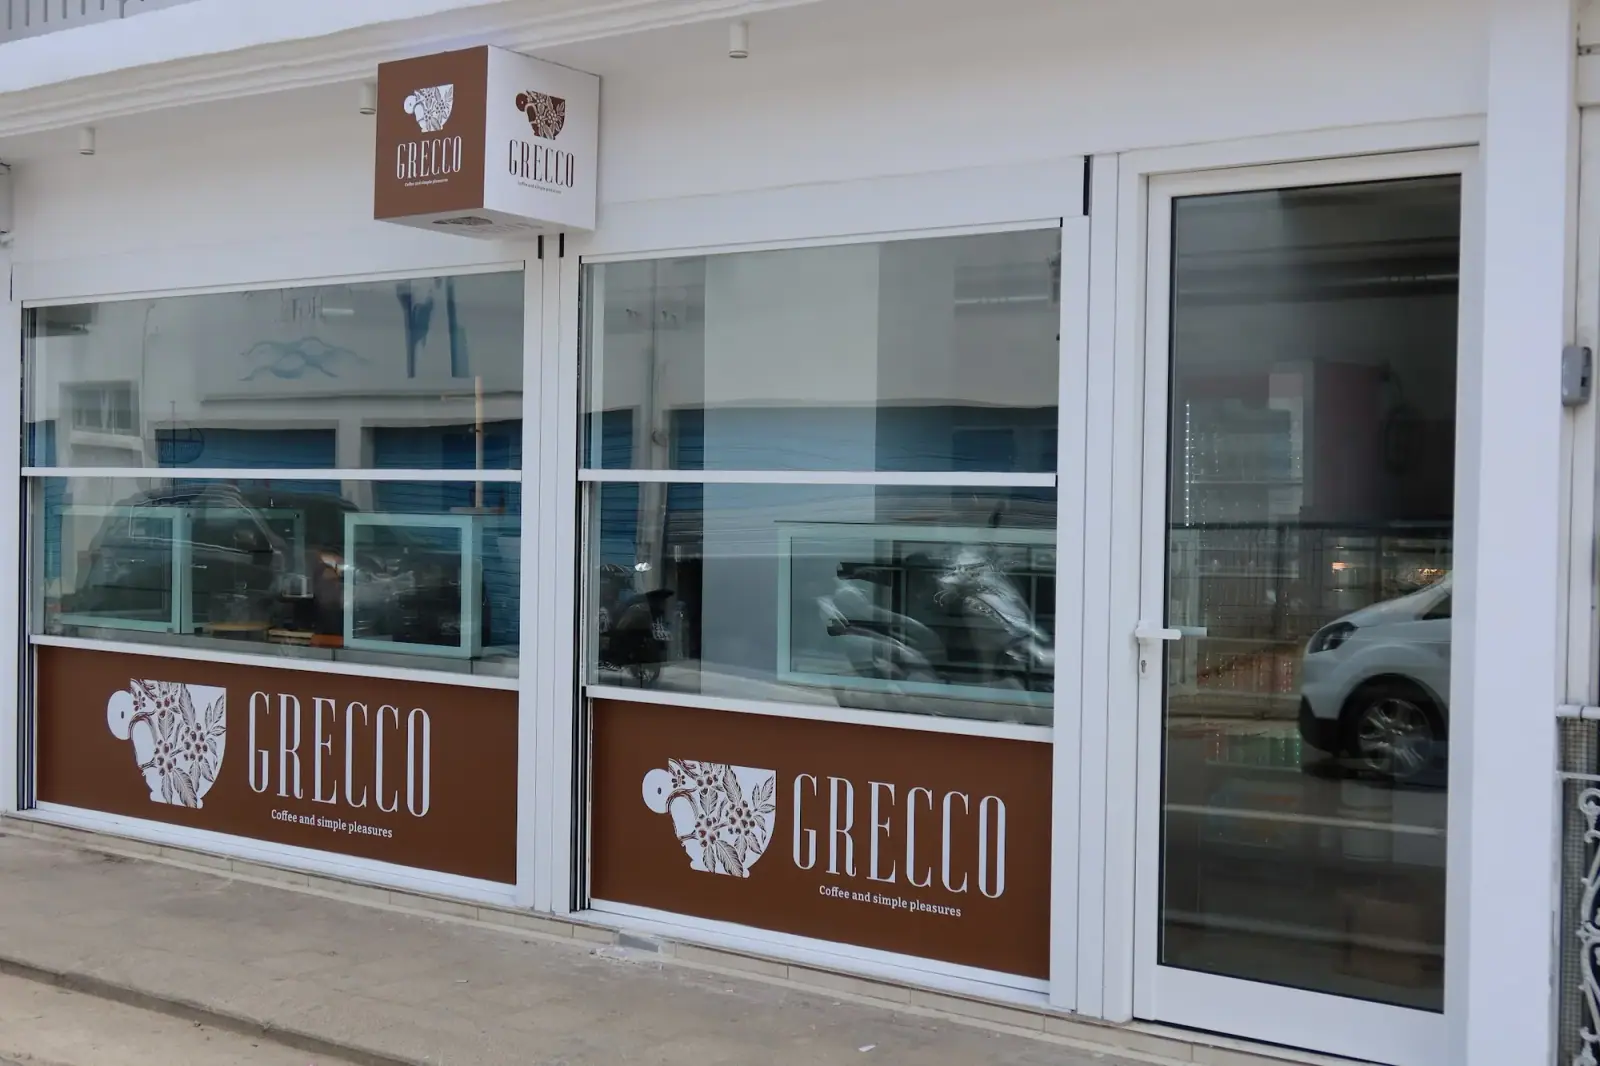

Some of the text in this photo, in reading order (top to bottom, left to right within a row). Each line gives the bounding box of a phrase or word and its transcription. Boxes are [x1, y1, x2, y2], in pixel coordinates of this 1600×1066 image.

[396, 136, 462, 179] GRECCO
[509, 139, 575, 188] GRECCO
[248, 691, 430, 818] GRECCO
[271, 809, 393, 838] Coffee and simple pleasures
[792, 773, 1006, 898] GRECCO
[819, 885, 962, 917] Coffee and simple pleasures
